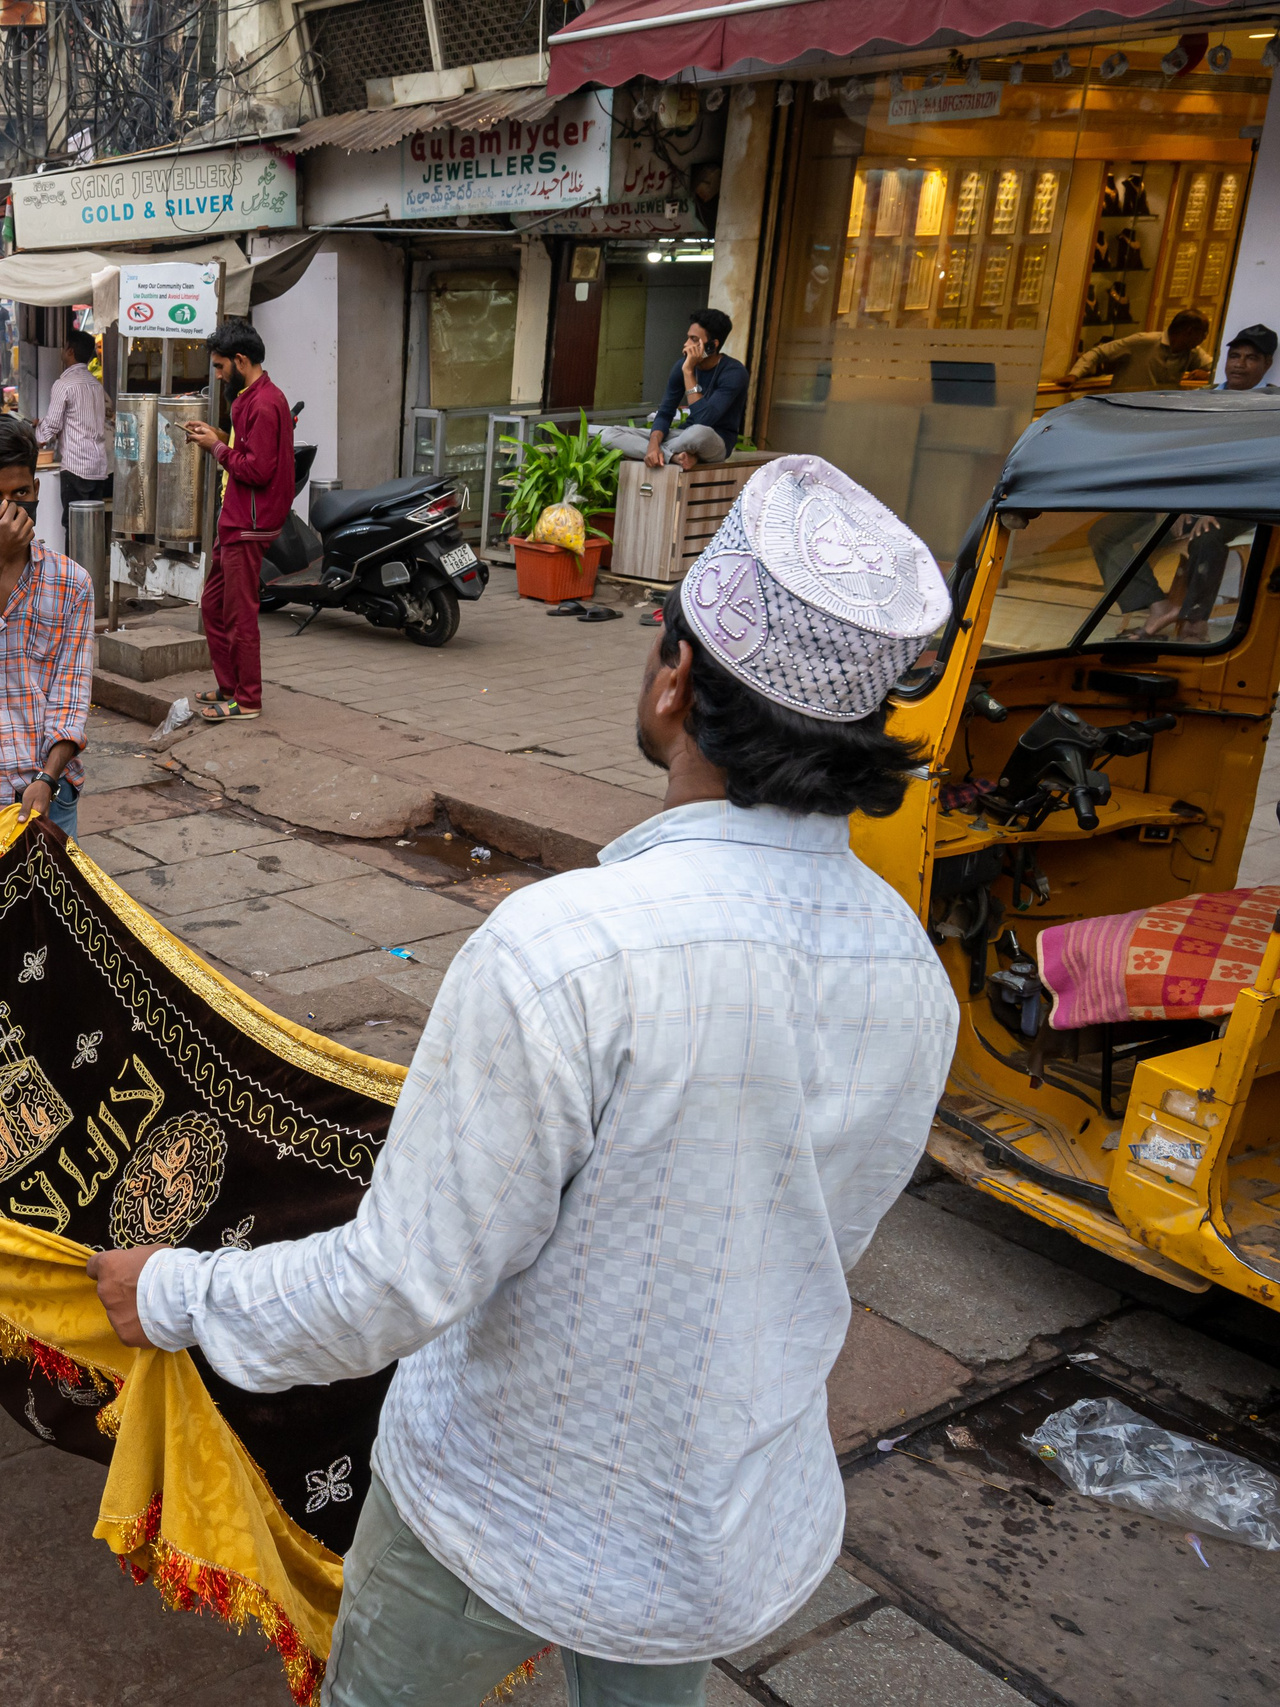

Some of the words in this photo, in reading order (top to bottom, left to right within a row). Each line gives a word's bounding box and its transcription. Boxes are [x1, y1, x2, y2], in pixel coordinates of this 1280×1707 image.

[410, 128, 502, 162] Gulam
[508, 115, 596, 155] Hyder
[71, 172, 125, 201] SANA
[132, 162, 243, 200] JEWELLERS
[81, 203, 135, 224] GOLD
[143, 201, 156, 219] &
[165, 194, 234, 217] SILVER
